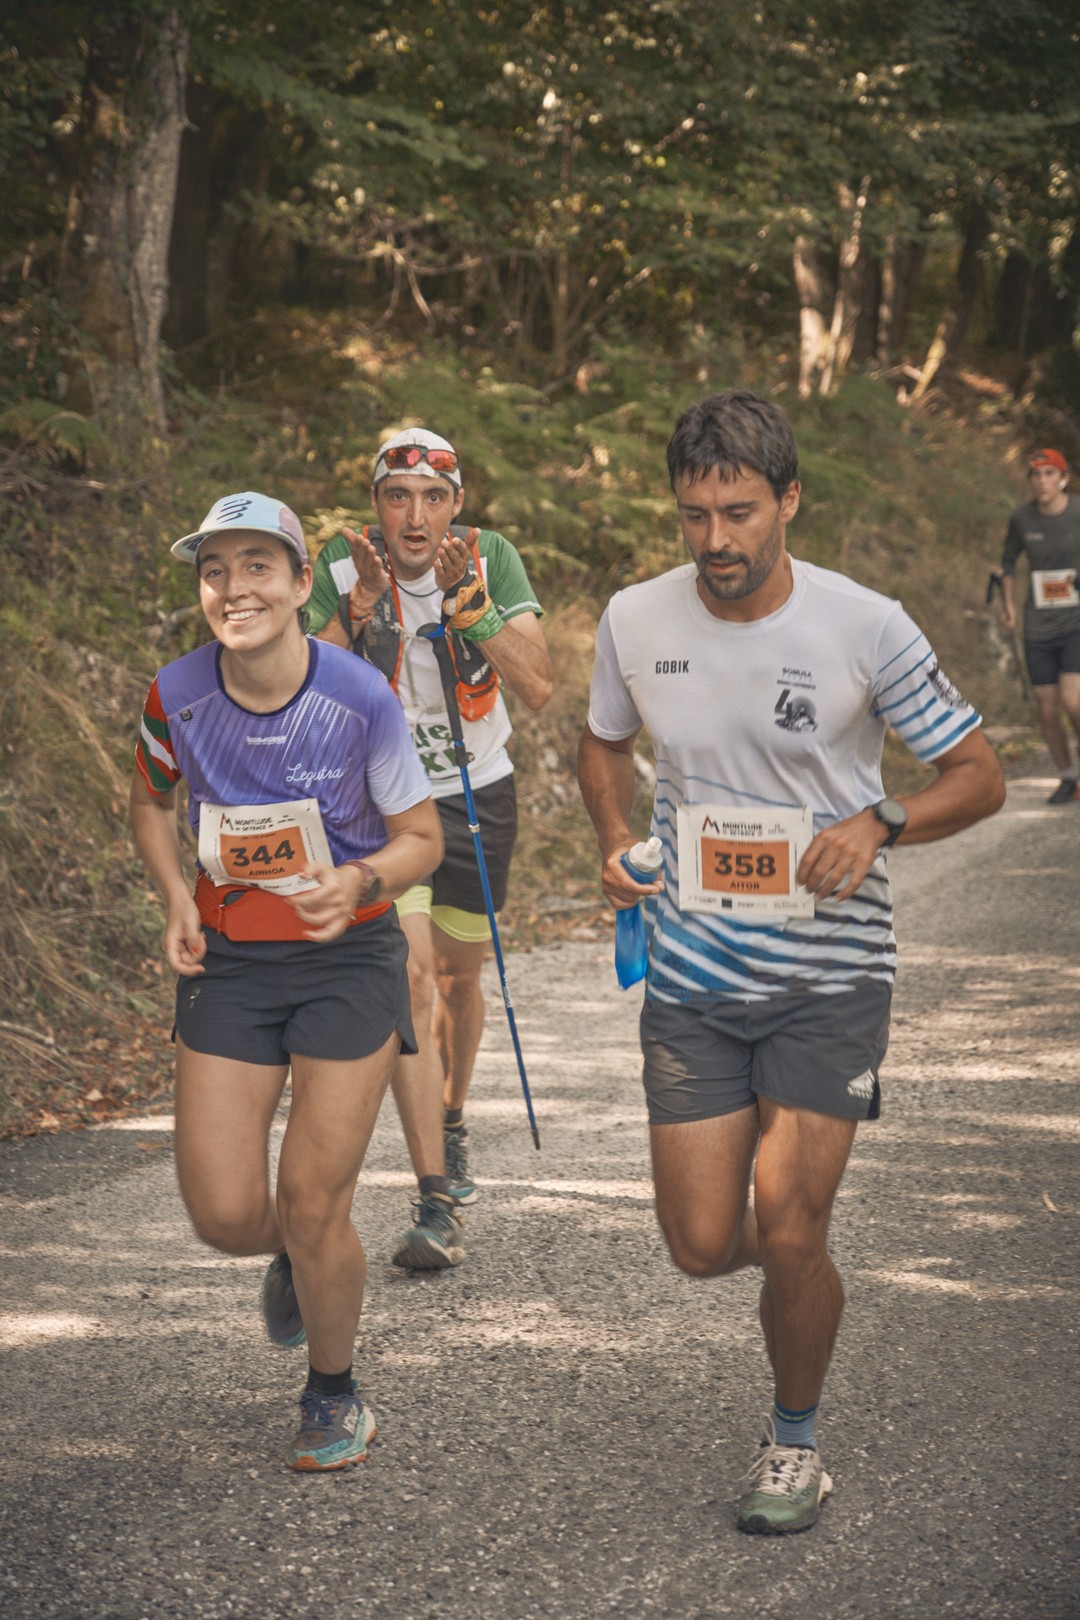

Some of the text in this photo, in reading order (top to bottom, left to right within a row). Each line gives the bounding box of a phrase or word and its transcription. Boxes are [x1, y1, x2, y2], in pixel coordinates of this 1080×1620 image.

[655, 660, 690, 675] GOBIK
[285, 763, 345, 788] Legutra
[229, 839, 295, 867] 344
[714, 850, 776, 878] 358
[729, 880, 761, 891] AITOR
